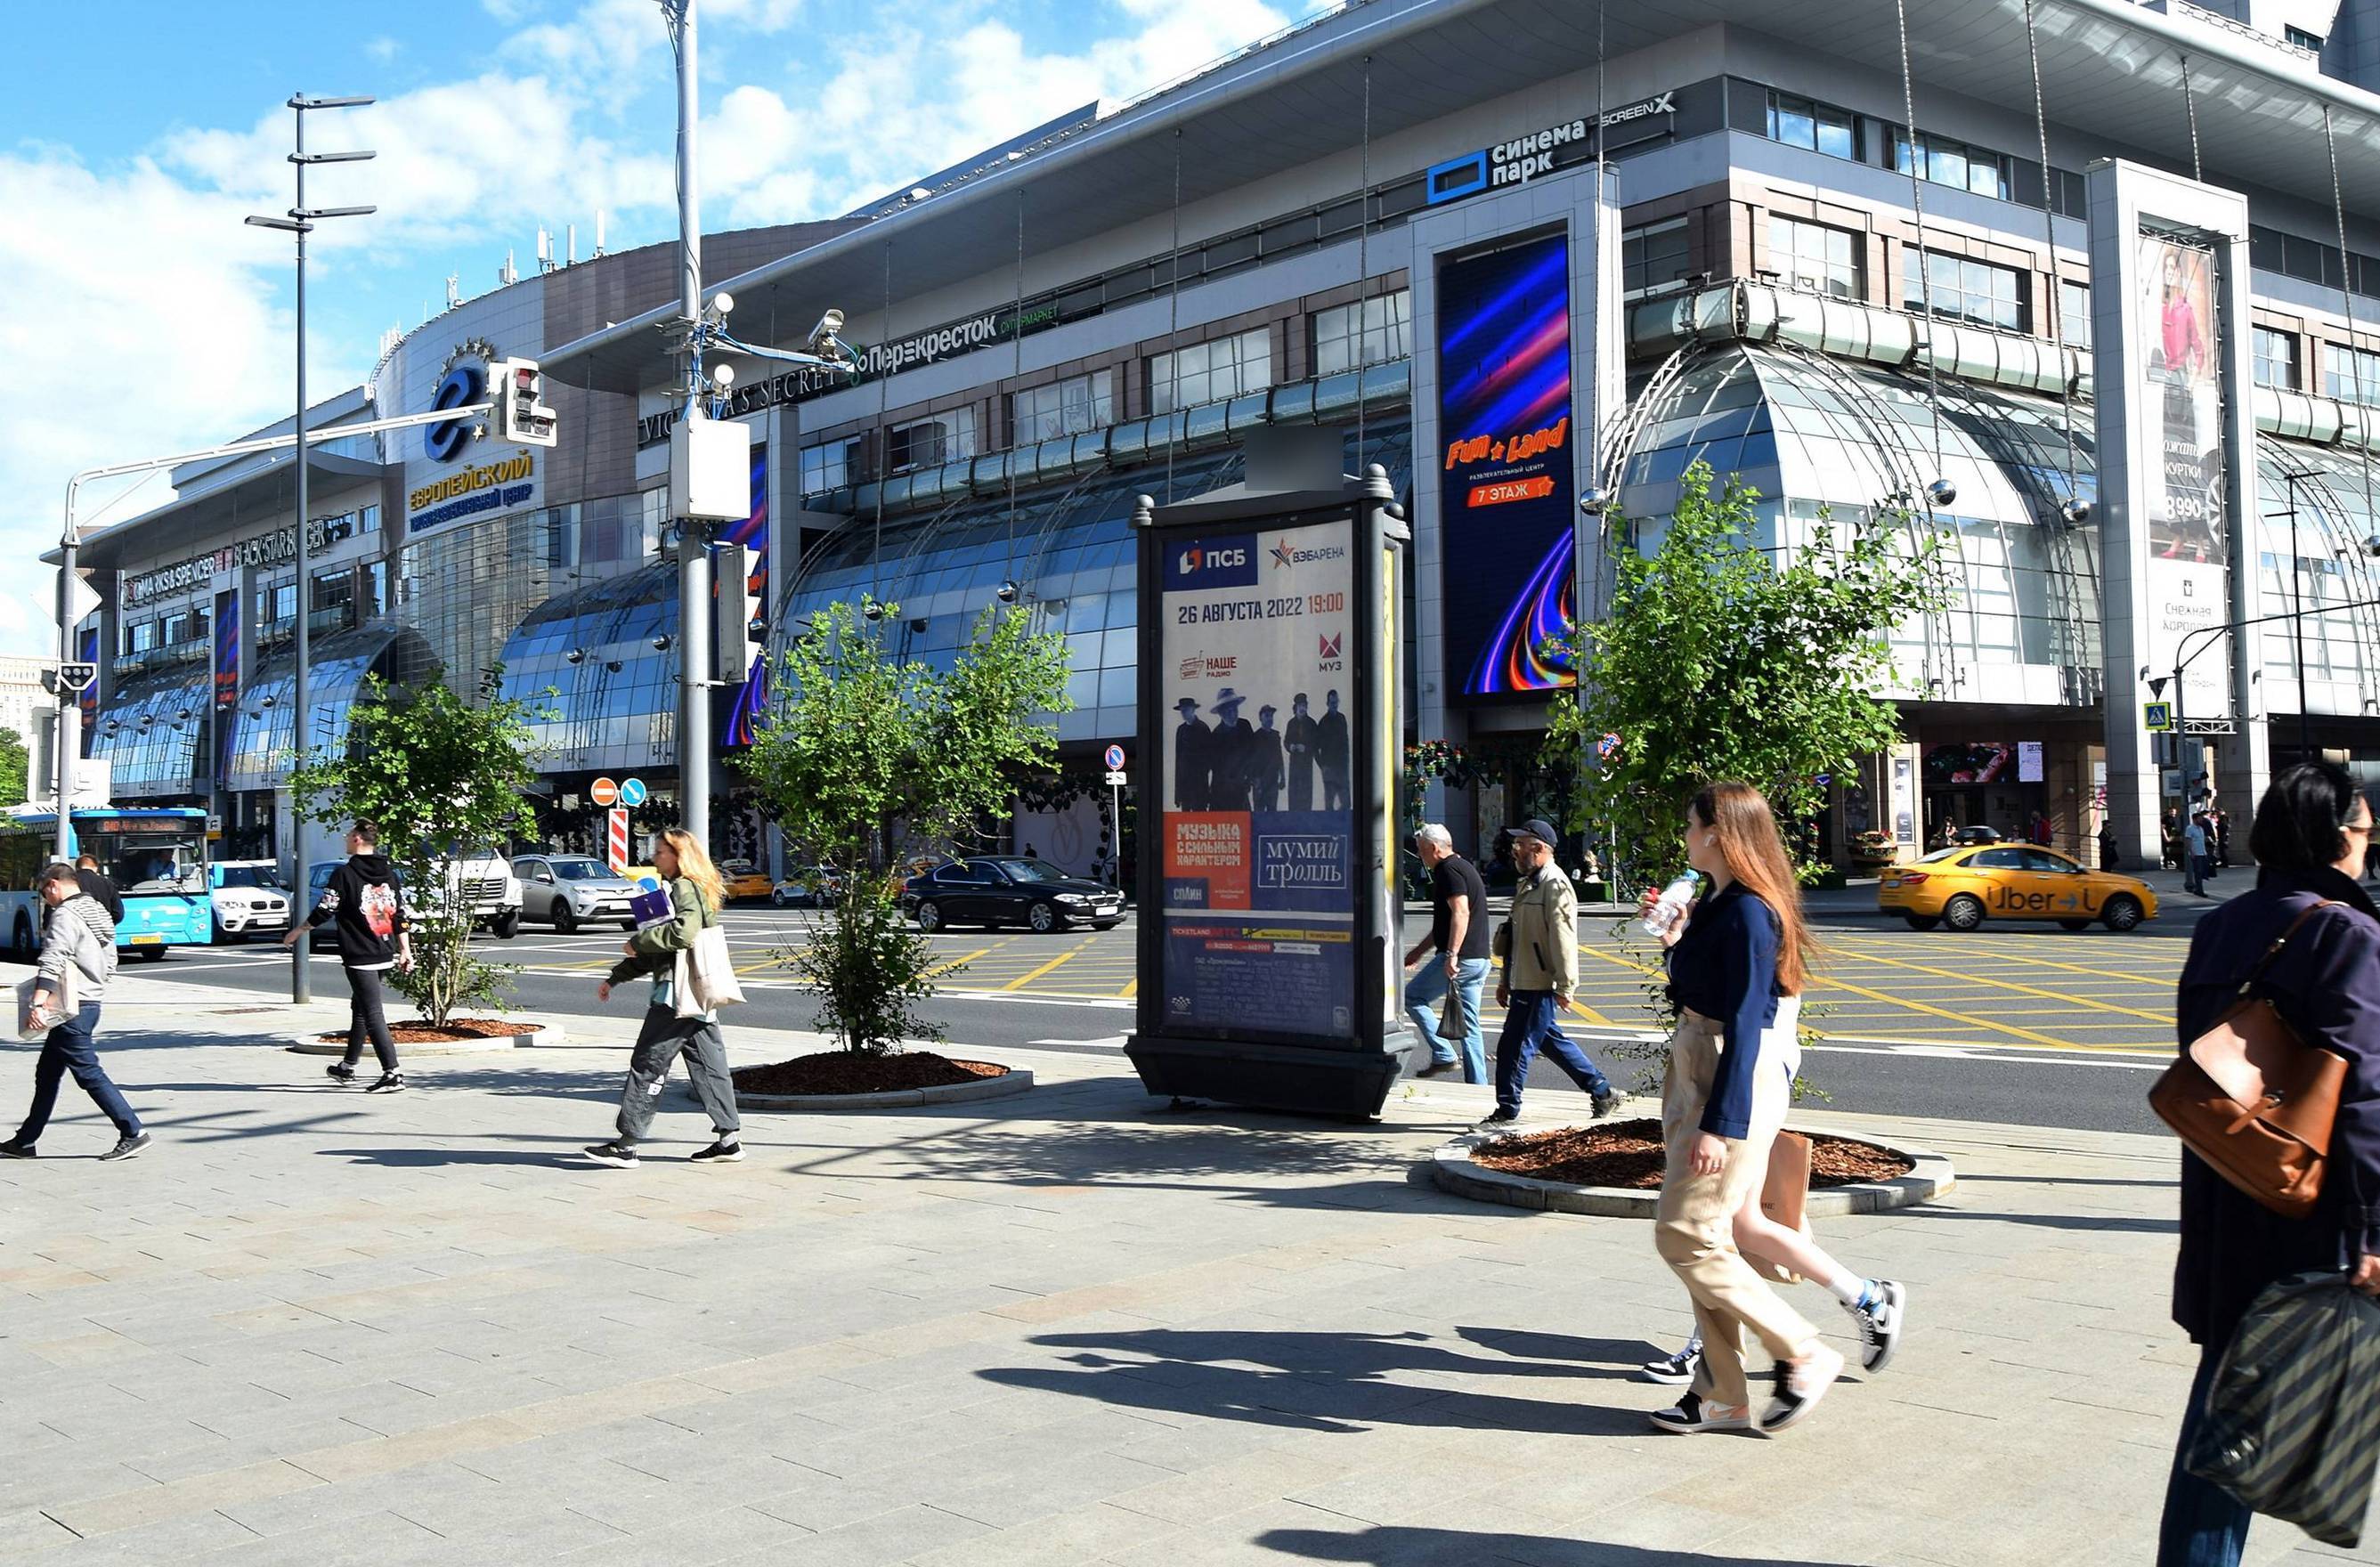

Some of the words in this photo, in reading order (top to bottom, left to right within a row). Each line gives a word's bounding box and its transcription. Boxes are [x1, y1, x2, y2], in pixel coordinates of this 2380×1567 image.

[1601, 92, 1677, 126] SCREENX
[1492, 120, 1587, 164] синема
[1492, 151, 1554, 185] парк
[760, 368, 836, 407] SECRET
[1445, 434, 1491, 470] Fun
[1506, 417, 1568, 463] Land
[410, 450, 532, 511] ЕВРОПЕЙСКИЙ
[2165, 462, 2201, 479] КУРТКИ
[1478, 491, 1485, 502] 7
[1490, 483, 1529, 500] ЭТАЖ
[1206, 548, 1246, 568] ПСБ
[1179, 605, 1198, 624] 26
[1202, 601, 1263, 622] АВГУСТА
[1268, 597, 1303, 618] 2022
[1308, 592, 1343, 613] 19:00
[1206, 657, 1237, 670] НАШЕ
[1319, 662, 1342, 672] МУЗ
[1176, 824, 1240, 840] МУЗЫКА
[1177, 841, 1184, 853] С
[1186, 841, 1240, 853] СИЛЬНЫМ
[1176, 855, 1240, 865] ХАРАКТЕРОМ
